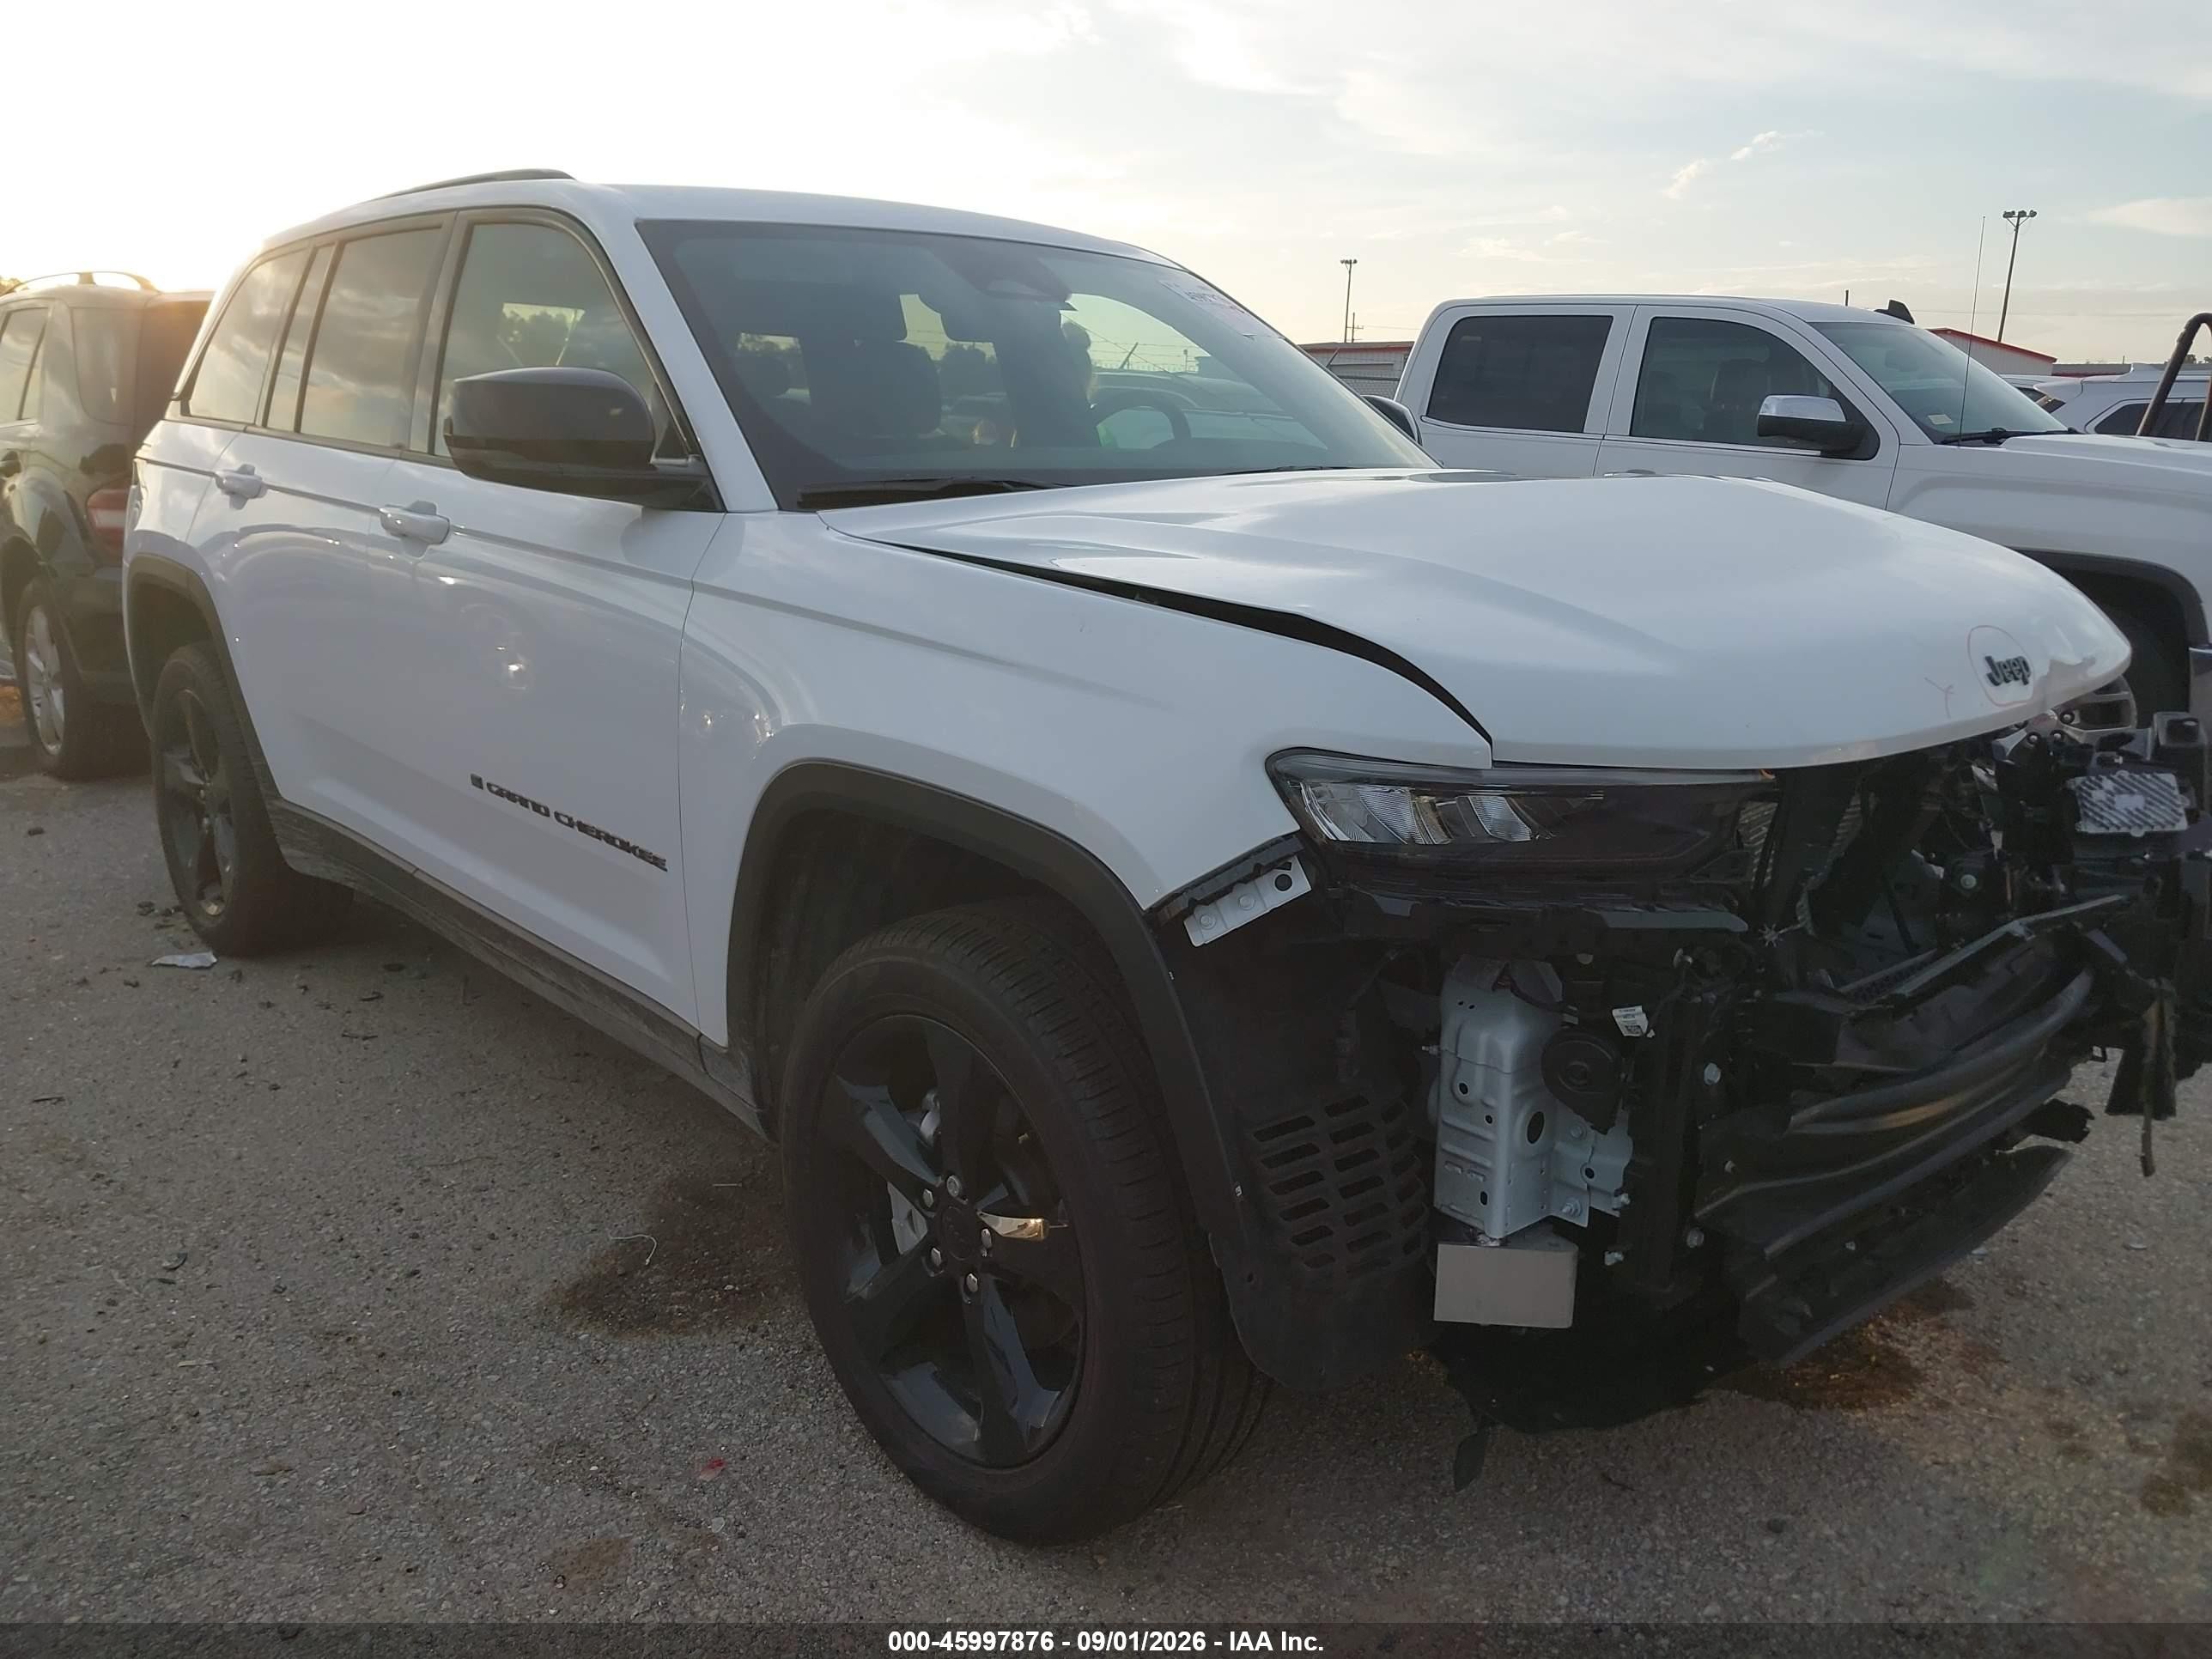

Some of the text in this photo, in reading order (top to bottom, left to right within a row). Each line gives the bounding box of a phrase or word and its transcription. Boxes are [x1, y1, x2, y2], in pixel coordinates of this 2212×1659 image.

[1984, 654, 2033, 687] Jeep
[486, 781, 668, 872] GRAND CHEROKEE
